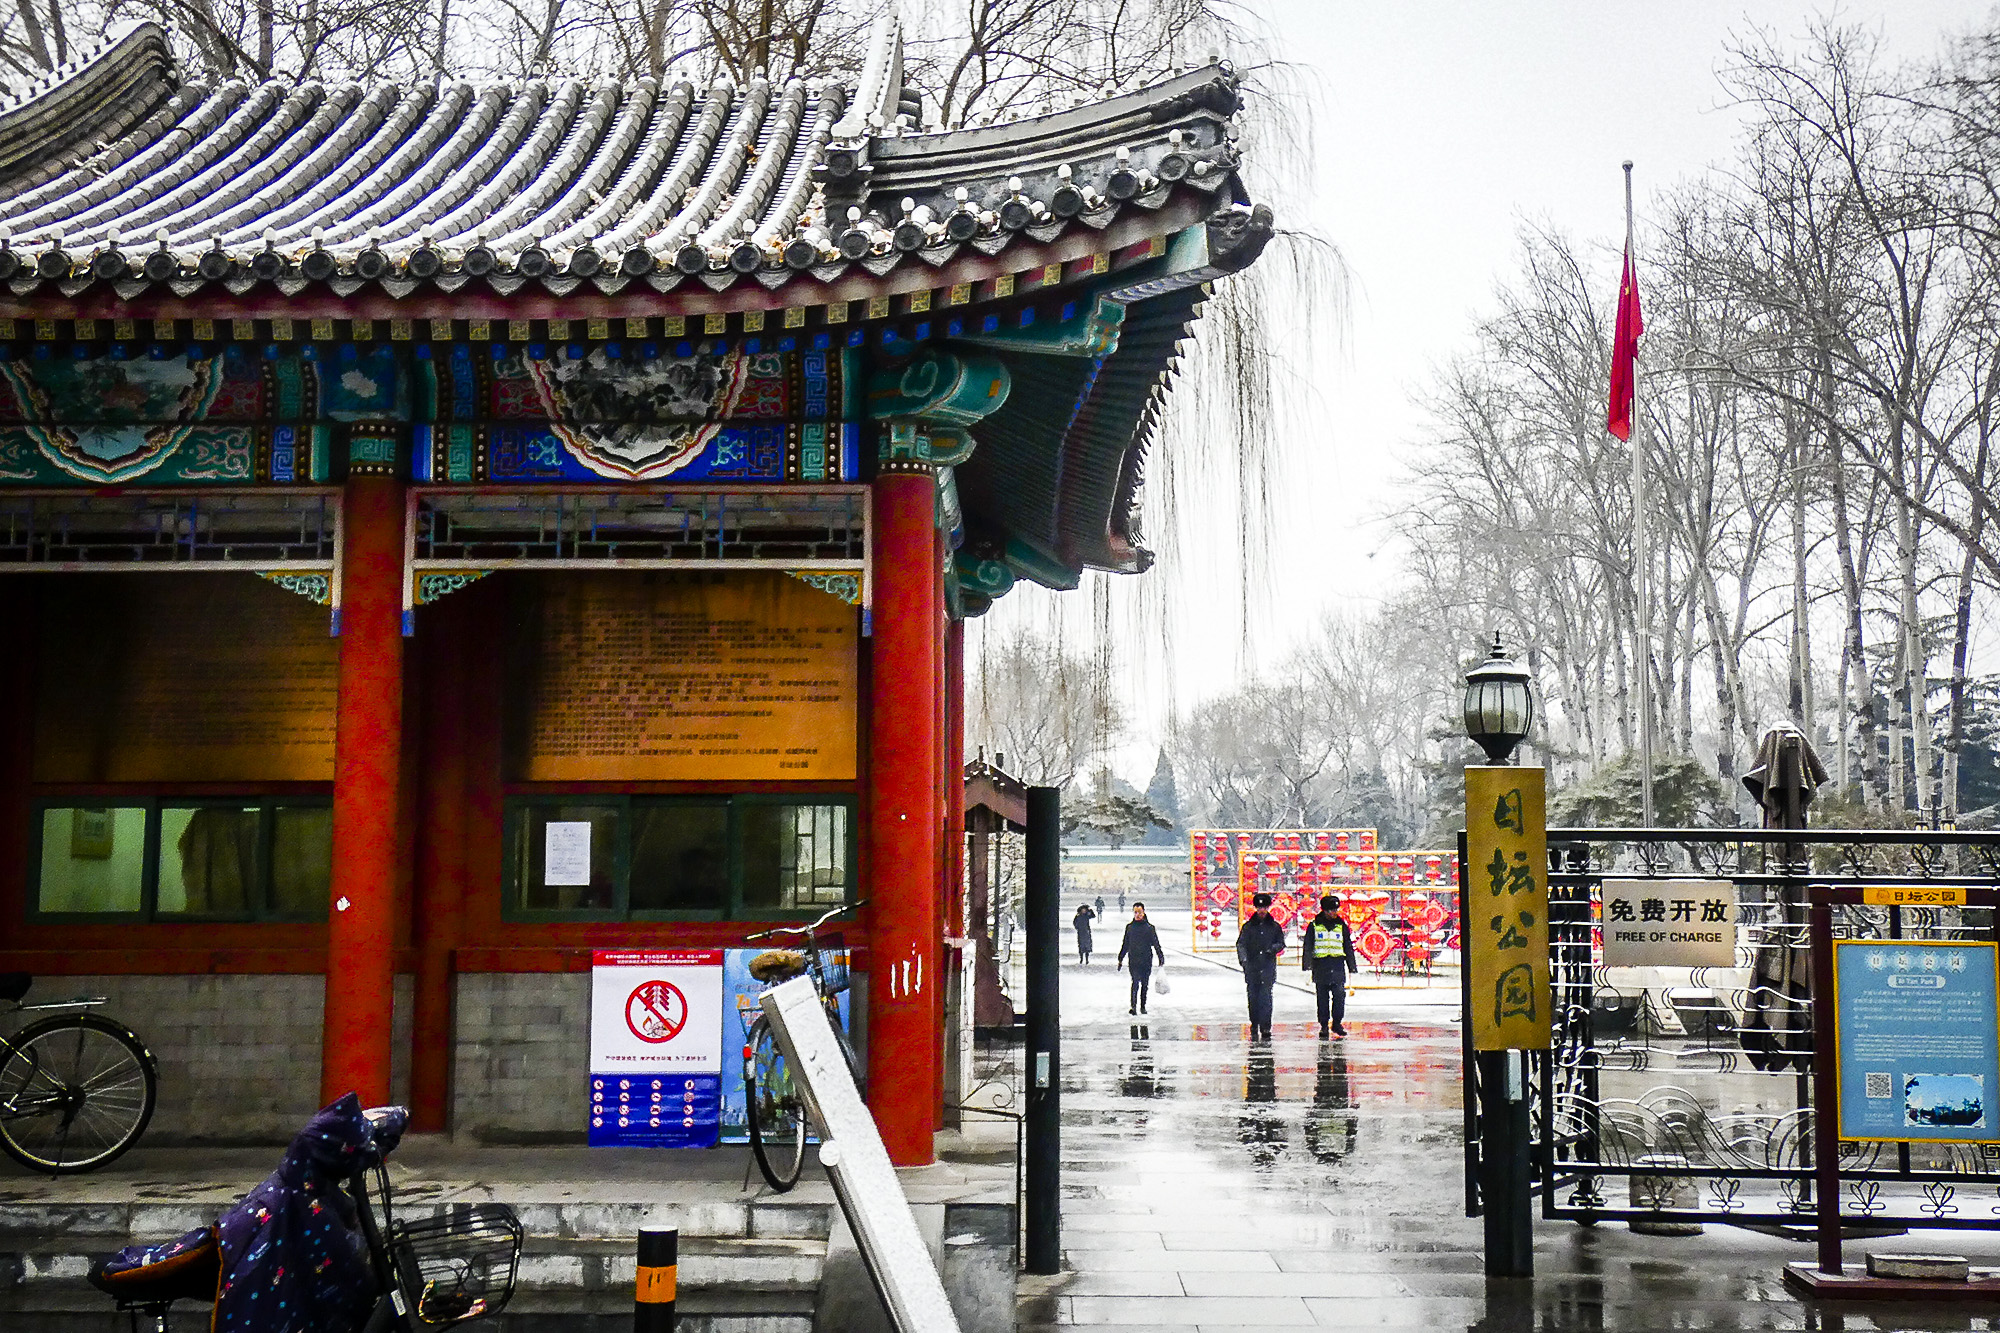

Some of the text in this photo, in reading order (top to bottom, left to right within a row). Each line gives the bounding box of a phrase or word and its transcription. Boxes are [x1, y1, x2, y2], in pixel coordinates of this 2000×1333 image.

[1894, 891, 1955, 902] 日坛公园
[1487, 787, 1536, 1027] 日坛公园
[1608, 898, 1728, 922] 免费开放
[1615, 931, 1722, 943] FREE OF CHARGE
